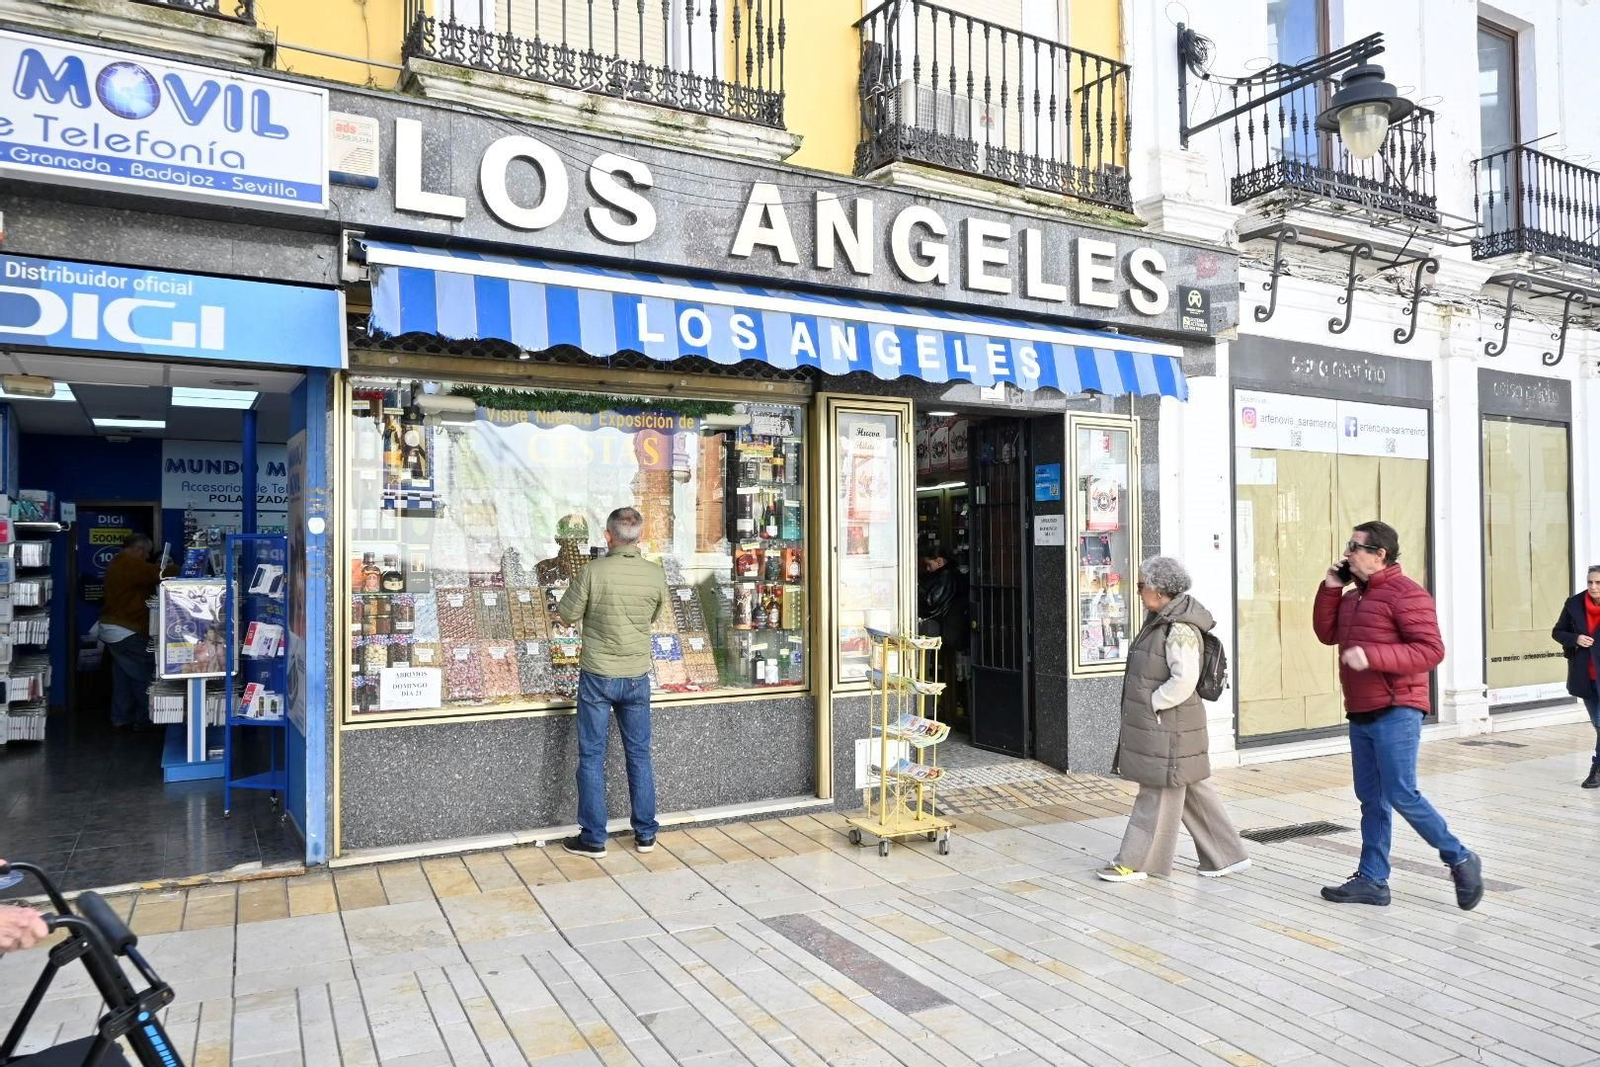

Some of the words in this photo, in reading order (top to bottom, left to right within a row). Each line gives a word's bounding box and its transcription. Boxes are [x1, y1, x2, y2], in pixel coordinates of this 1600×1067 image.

[13, 47, 289, 140] MOVIL
[34, 113, 246, 170] Telefonía
[10, 147, 111, 174] Granada
[130, 162, 214, 188] Badajoz
[232, 176, 297, 198] Sevilla
[395, 117, 657, 244] LOS
[731, 179, 1170, 315] ANGELES
[5, 261, 127, 290] Distribuidor
[133, 277, 193, 297] oficial
[0, 285, 225, 351] DIGI
[636, 302, 758, 350] LOS
[790, 319, 1041, 380] ANGELES
[487, 407, 528, 423] Visite
[536, 409, 592, 427] Nuestra
[601, 411, 674, 430] Exposición
[679, 414, 695, 429] de
[528, 433, 660, 466] CESTAS
[181, 481, 243, 494] Accesorio
[208, 494, 288, 504] POLAZADA
[97, 514, 124, 524] DIGI
